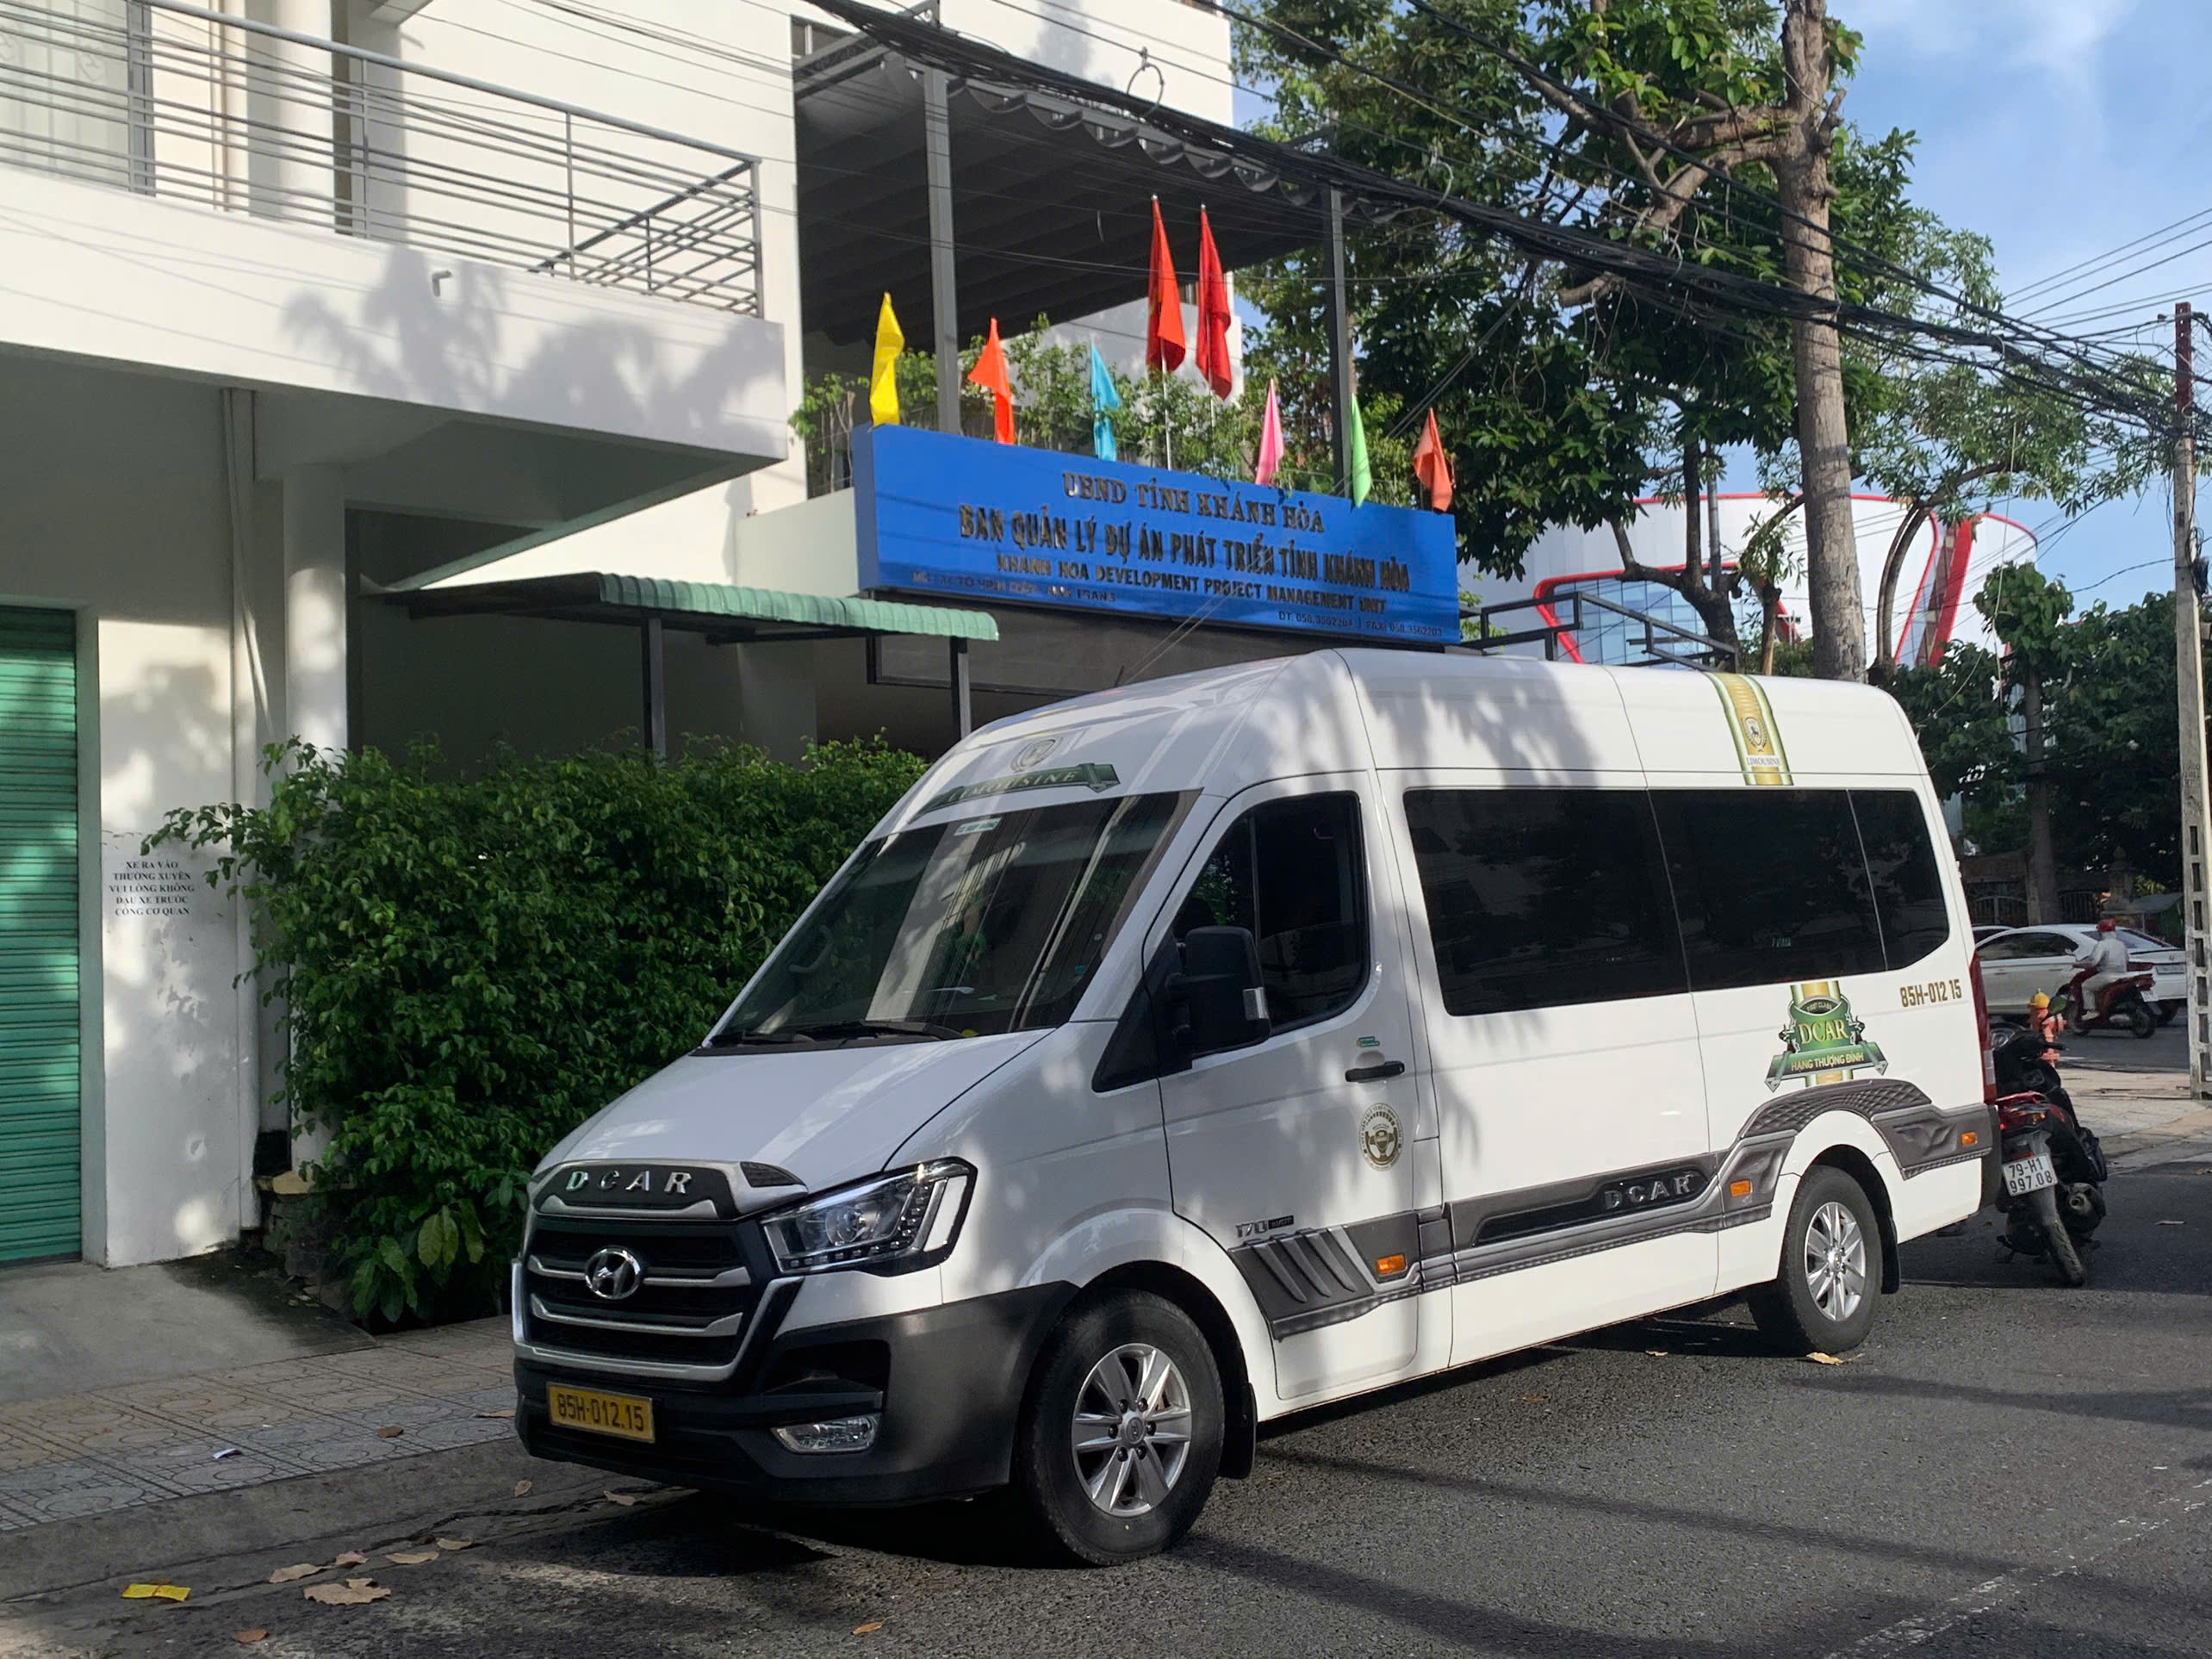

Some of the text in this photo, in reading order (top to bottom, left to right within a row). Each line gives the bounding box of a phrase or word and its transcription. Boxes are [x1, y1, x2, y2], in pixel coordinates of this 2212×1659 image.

[1063, 473, 1127, 504] UBND
[1134, 476, 1190, 513] TỈNH
[1196, 491, 1276, 526] KHÁNH
[960, 503, 1003, 542] BAN
[1011, 503, 1067, 551] QUẢN
[1075, 515, 1097, 553] LÝ
[1104, 519, 1131, 565] DỰ
[1138, 522, 1163, 562] ÁN
[1170, 530, 1216, 568] PHÁT
[1222, 531, 1275, 575] TRIỂN
[1278, 539, 1318, 581] TỈNH
[1323, 550, 1376, 587] KHÁNH
[1058, 560, 1089, 580] HOA
[1095, 564, 1200, 593] DEVELOPMENT
[1203, 578, 1262, 599] PROJECT
[1267, 585, 1355, 611] MANAGEMENT
[1359, 596, 1386, 614] UNIT
[126, 861, 139, 869] XE
[141, 861, 155, 869] RA
[162, 907, 190, 916] QUAN
[1798, 1020, 1849, 1044] DCAR
[2009, 1157, 2043, 1178] 79-H1
[565, 1170, 692, 1195] DCAR
[1604, 1173, 1694, 1210] DCAR
[2010, 1171, 2053, 1193] 997.08
[557, 1393, 645, 1432] 85H-012.15
